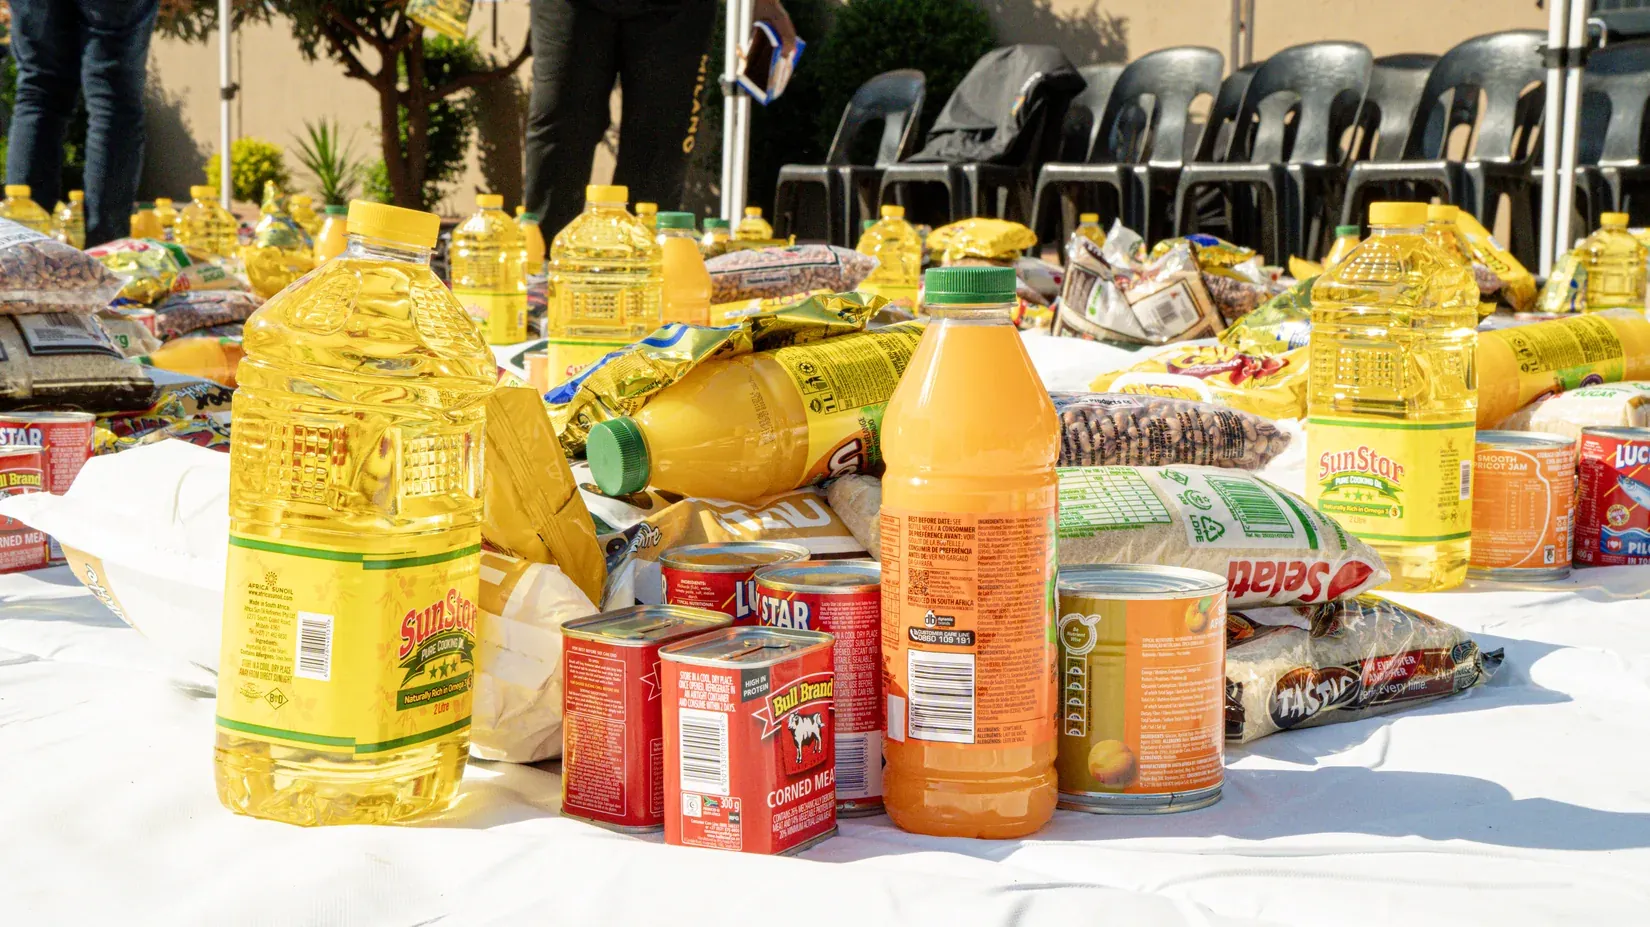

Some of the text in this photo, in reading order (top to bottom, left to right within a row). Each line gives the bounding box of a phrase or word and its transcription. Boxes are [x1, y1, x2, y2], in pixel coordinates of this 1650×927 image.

[0, 427, 42, 446] STAR
[1319, 446, 1405, 484] SunStar
[1477, 455, 1517, 463] SMOOTH
[1508, 463, 1528, 471] JAM
[9, 472, 41, 486] Brand
[1335, 475, 1383, 489] PURE COOKING OIL
[1363, 507, 1384, 515] Omega
[1189, 514, 1205, 543] LDPE
[908, 544, 931, 553] CONSUMIR
[248, 582, 294, 595] AFRICA SUNOIL
[248, 589, 293, 601] www.africasunoil.com
[955, 599, 975, 607] AFRICA
[761, 594, 809, 631] STAR
[398, 588, 477, 660] SunStar
[917, 634, 937, 643] 0860
[421, 637, 459, 661] PURE COOKING
[743, 682, 769, 697] PROTEIN
[745, 678, 760, 688] HIGH
[404, 682, 464, 704] Naturally Rich in Omega
[772, 677, 834, 717] Bull Brand
[1277, 674, 1354, 718] TASTIC
[433, 702, 449, 714] 2 Litre
[767, 766, 836, 809] CORNED MEA
[720, 796, 740, 813] 300 g
